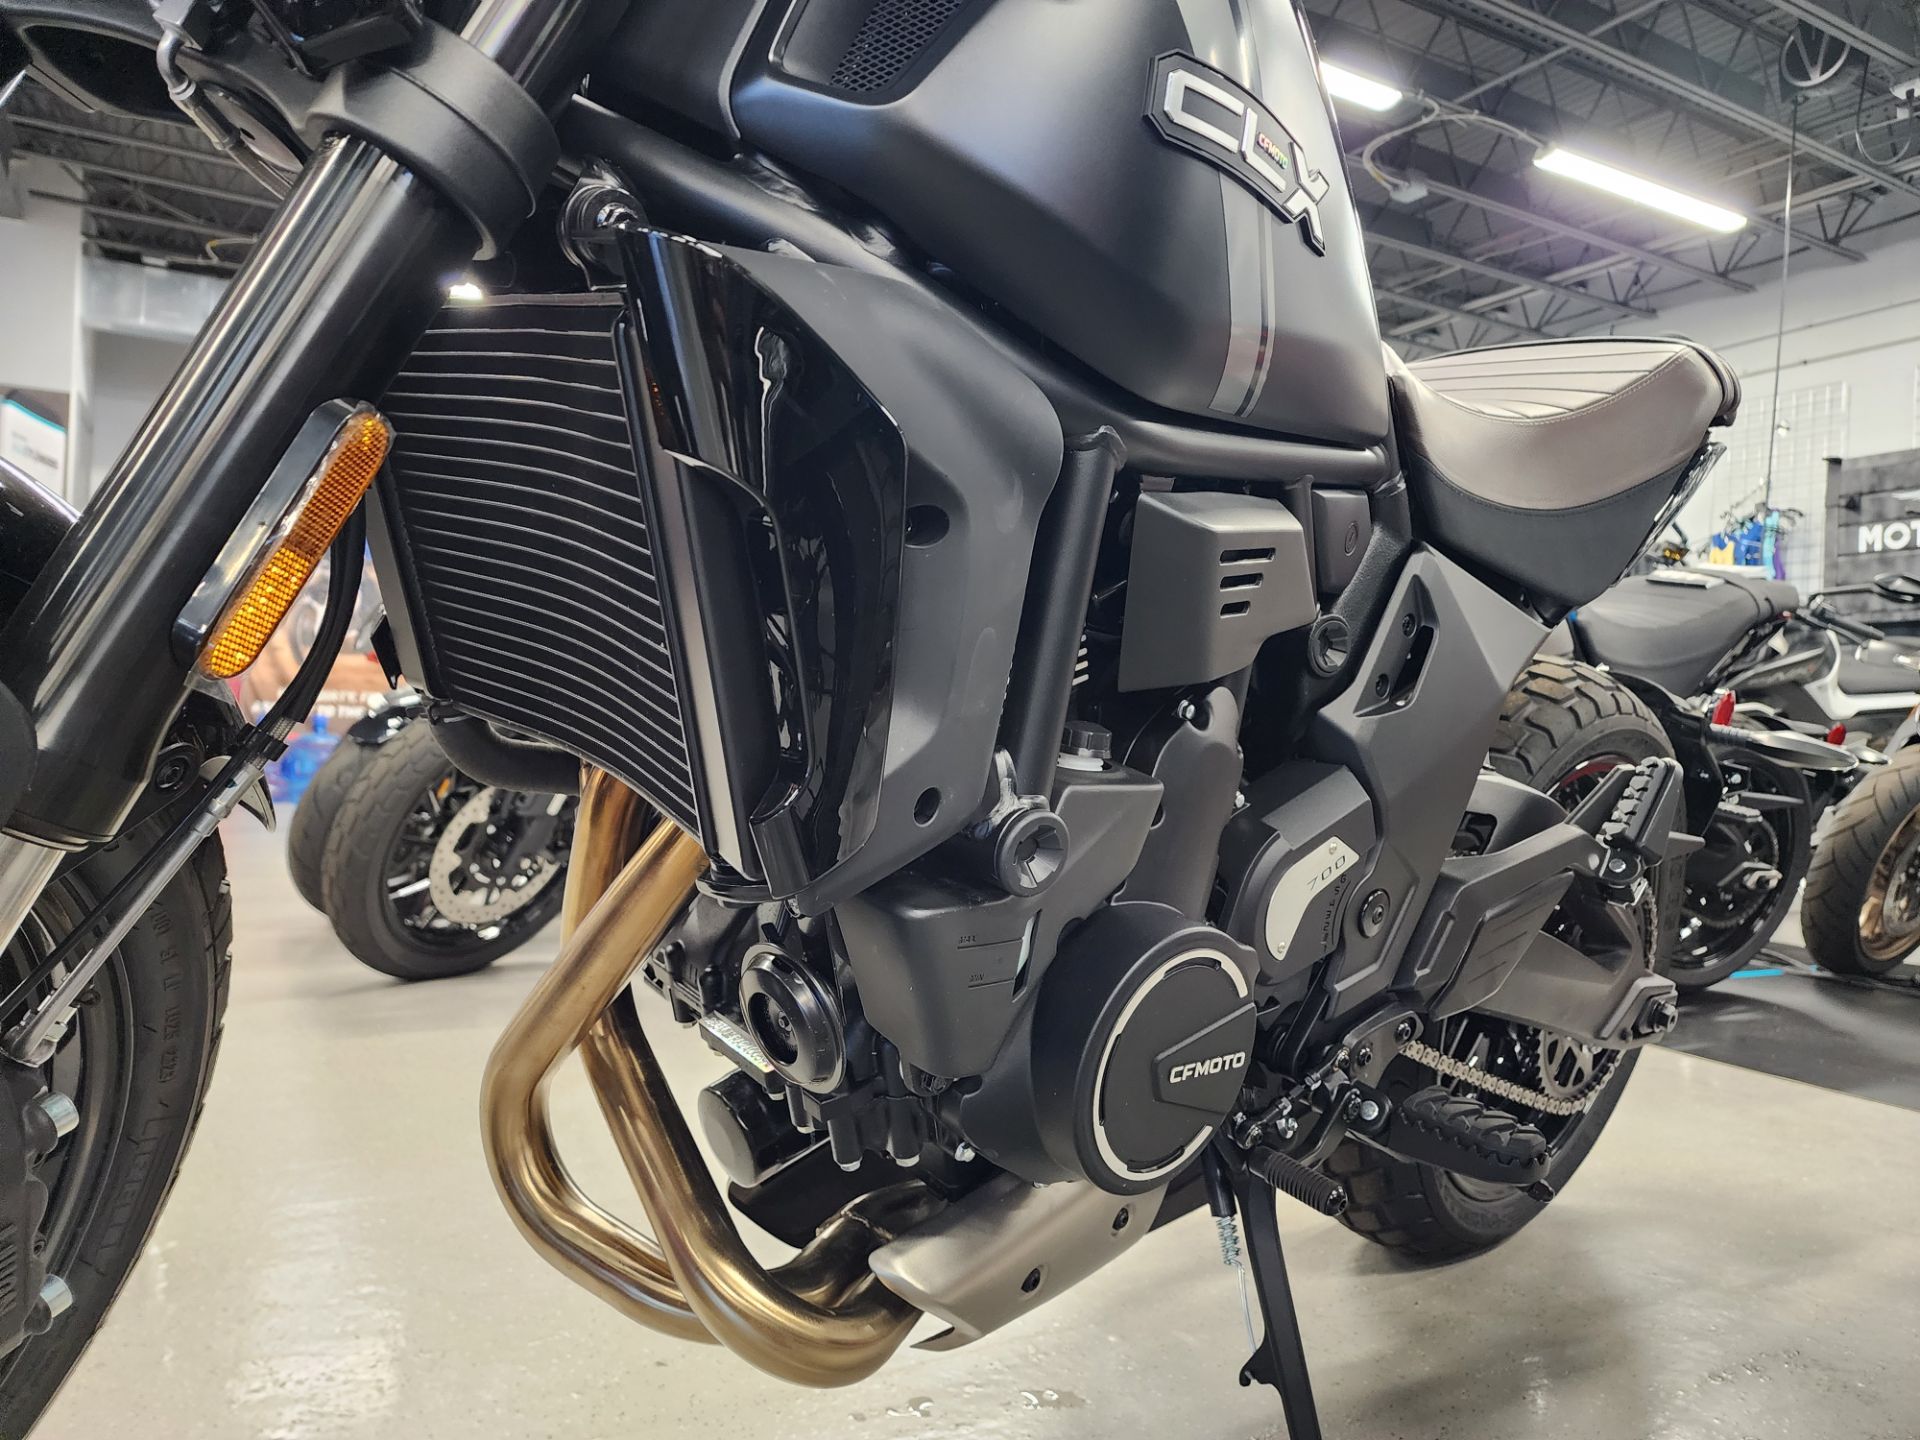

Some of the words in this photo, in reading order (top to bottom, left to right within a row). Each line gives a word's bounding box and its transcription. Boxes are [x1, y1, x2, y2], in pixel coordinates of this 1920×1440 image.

[1164, 68, 1330, 249] CLX
[1257, 131, 1289, 170] CFMOTO
[1306, 854, 1347, 891] 700
[1169, 1051, 1246, 1084] CFMOTO
